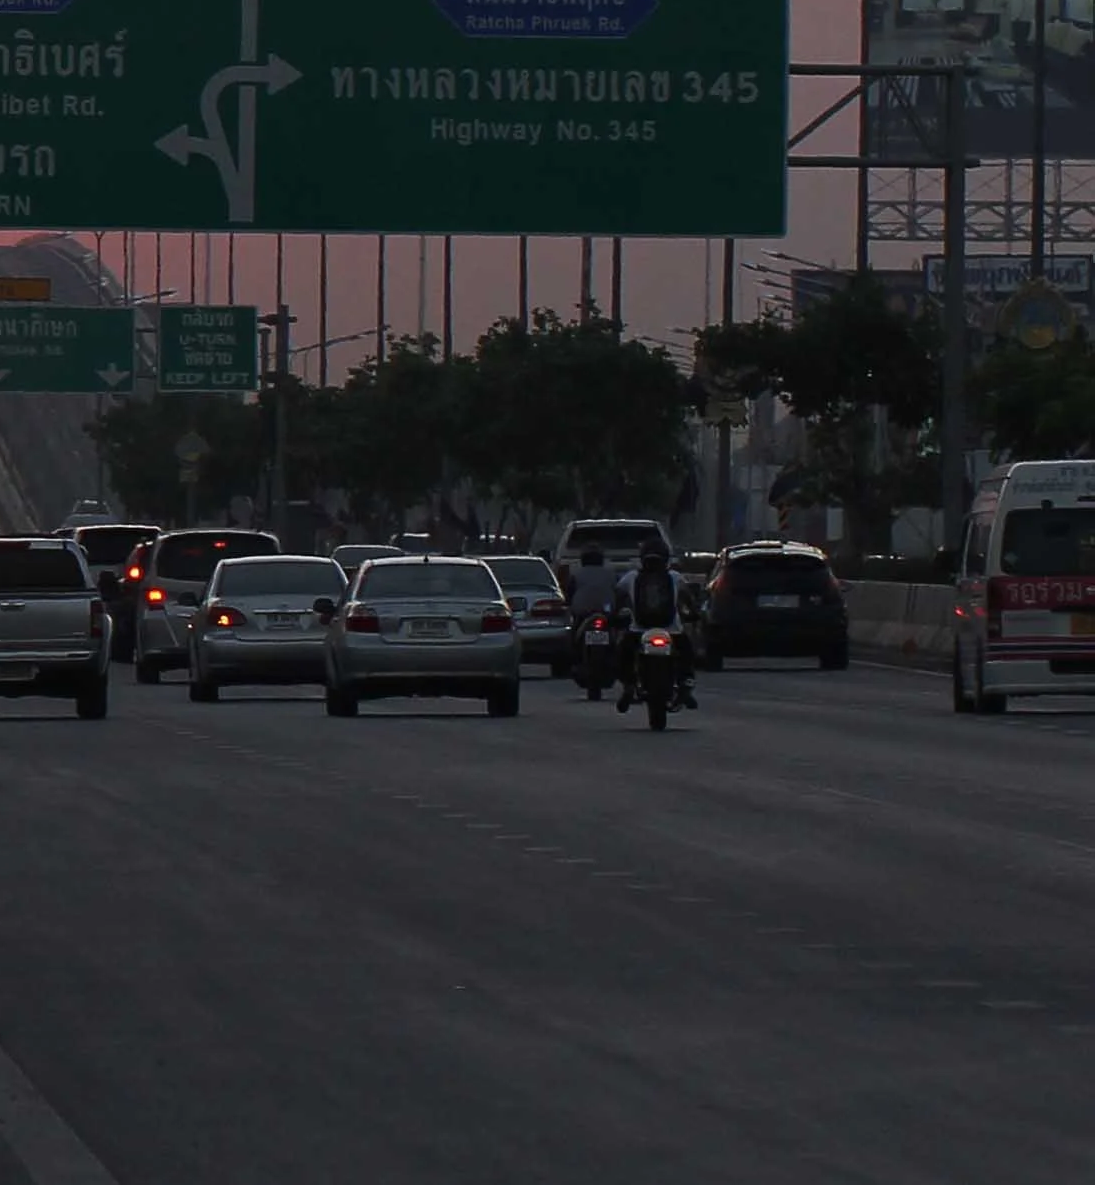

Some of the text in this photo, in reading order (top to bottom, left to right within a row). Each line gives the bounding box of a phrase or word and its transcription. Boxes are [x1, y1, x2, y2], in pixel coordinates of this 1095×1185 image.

[331, 65, 760, 104] ทางหลวงหมายเลข 345
[63, 96, 105, 117] Rd.
[430, 118, 657, 146] Highway No. 345
